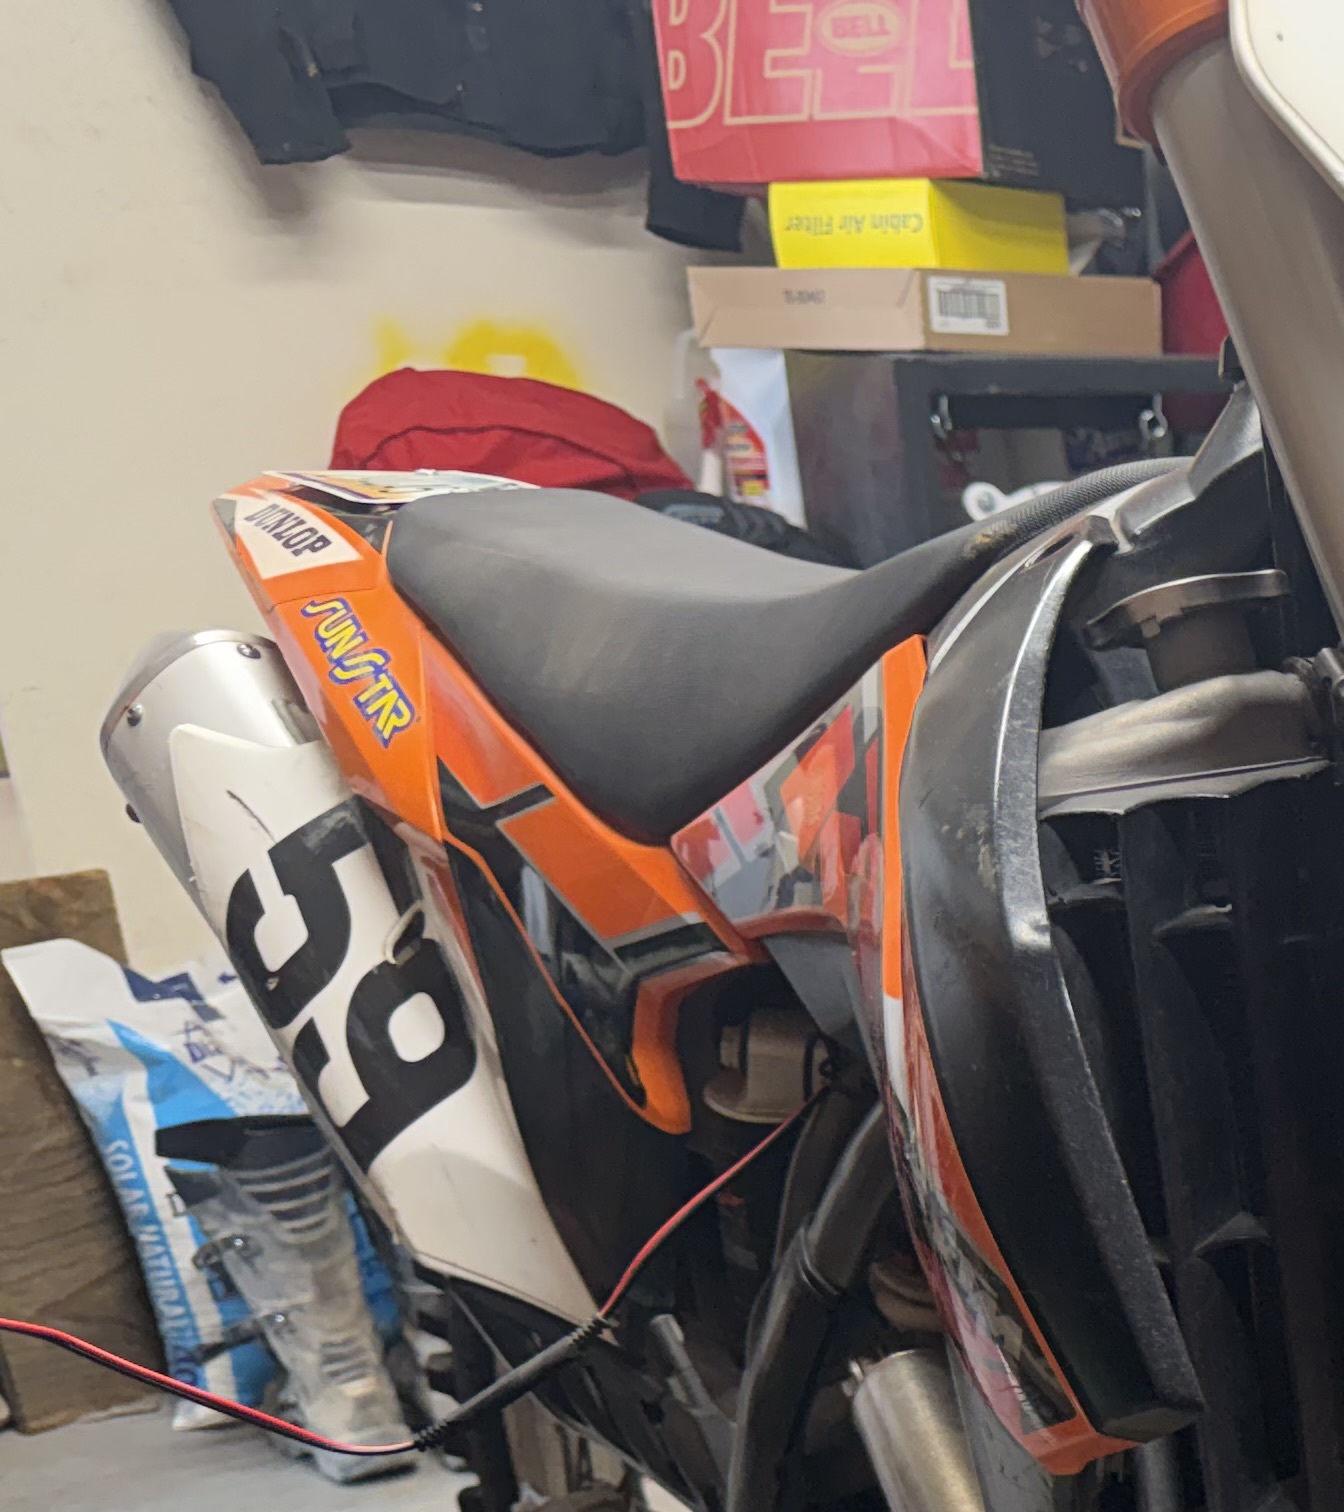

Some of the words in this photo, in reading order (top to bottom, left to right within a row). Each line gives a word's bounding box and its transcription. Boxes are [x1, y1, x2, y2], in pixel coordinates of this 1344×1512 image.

[784, 213, 835, 235] Filter
[839, 213, 867, 235] Air
[871, 212, 924, 233] Cabin
[243, 502, 332, 557] DUNLOP
[301, 597, 415, 747] SUNSTAR
[225, 800, 477, 1172] 59
